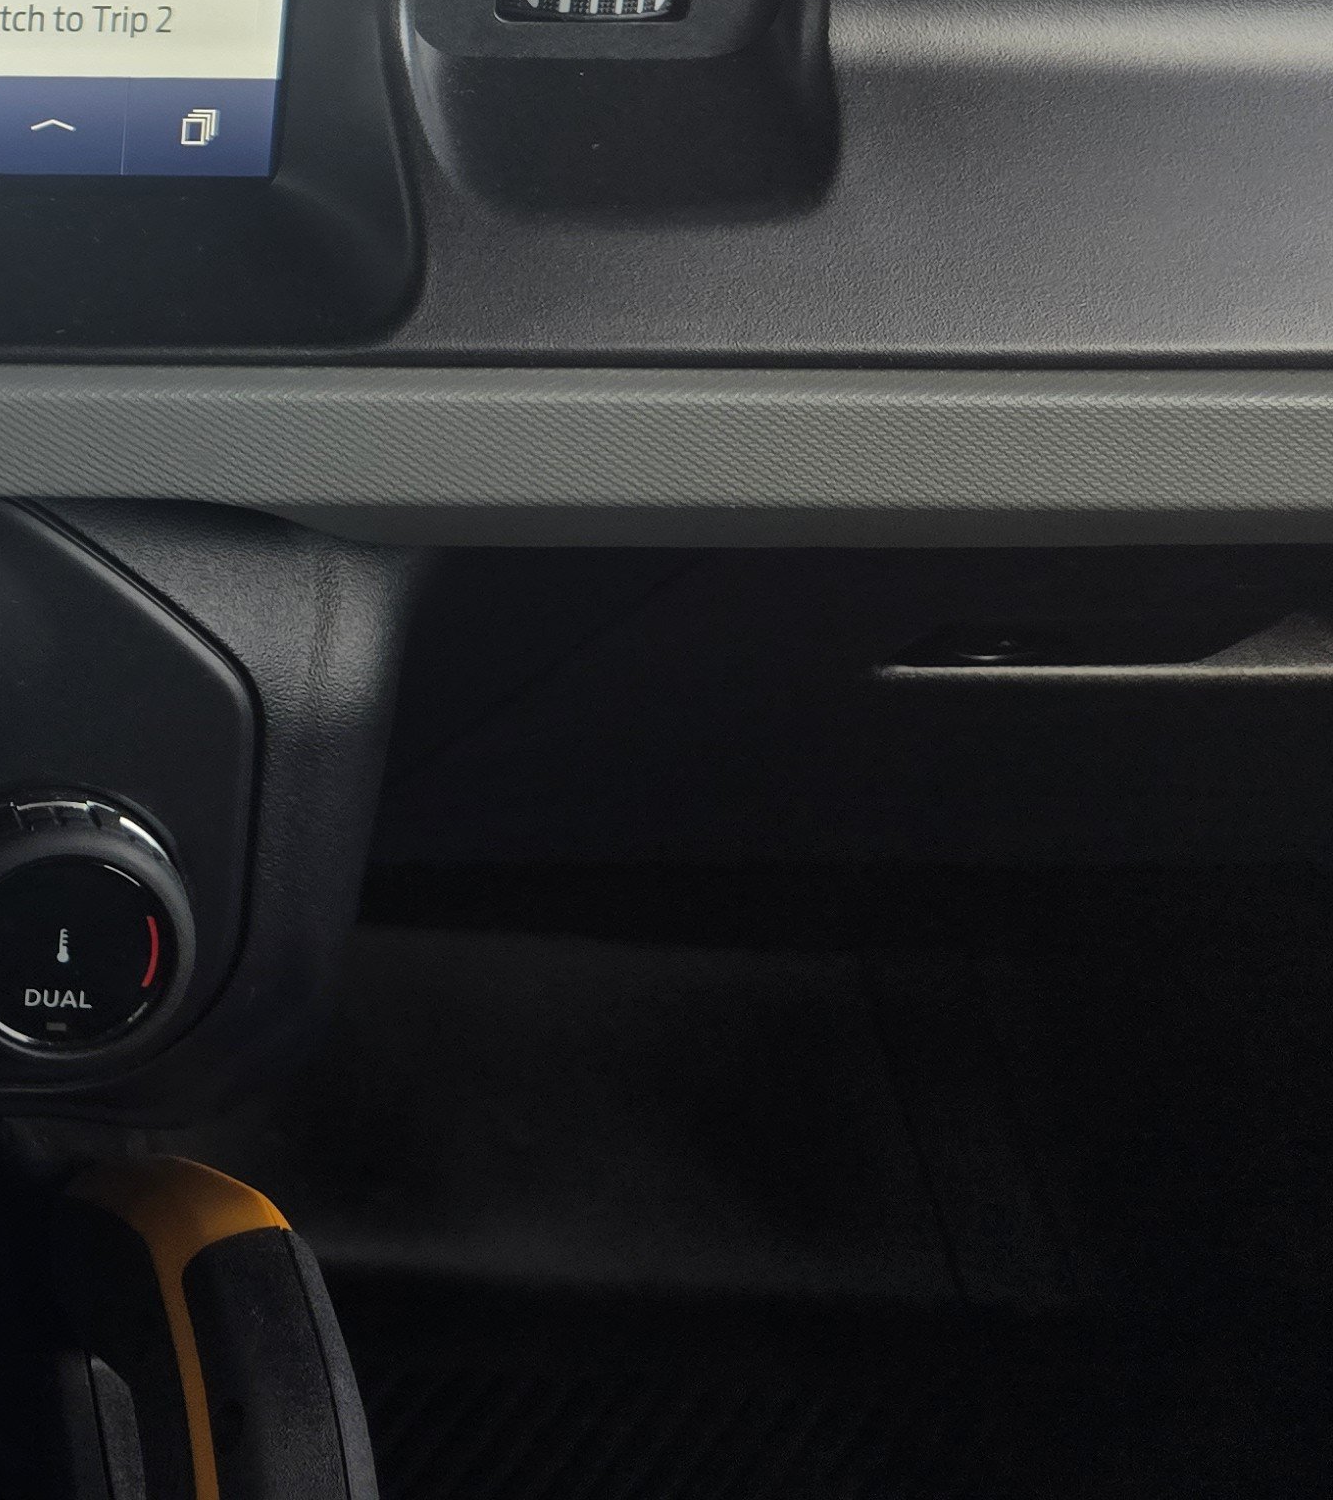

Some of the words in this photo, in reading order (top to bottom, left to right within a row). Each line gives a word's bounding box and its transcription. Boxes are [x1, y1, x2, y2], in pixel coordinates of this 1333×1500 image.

[54, 7, 83, 32] to
[93, 6, 148, 38] Trip
[156, 6, 172, 33] 2
[24, 988, 92, 1008] DUAL
